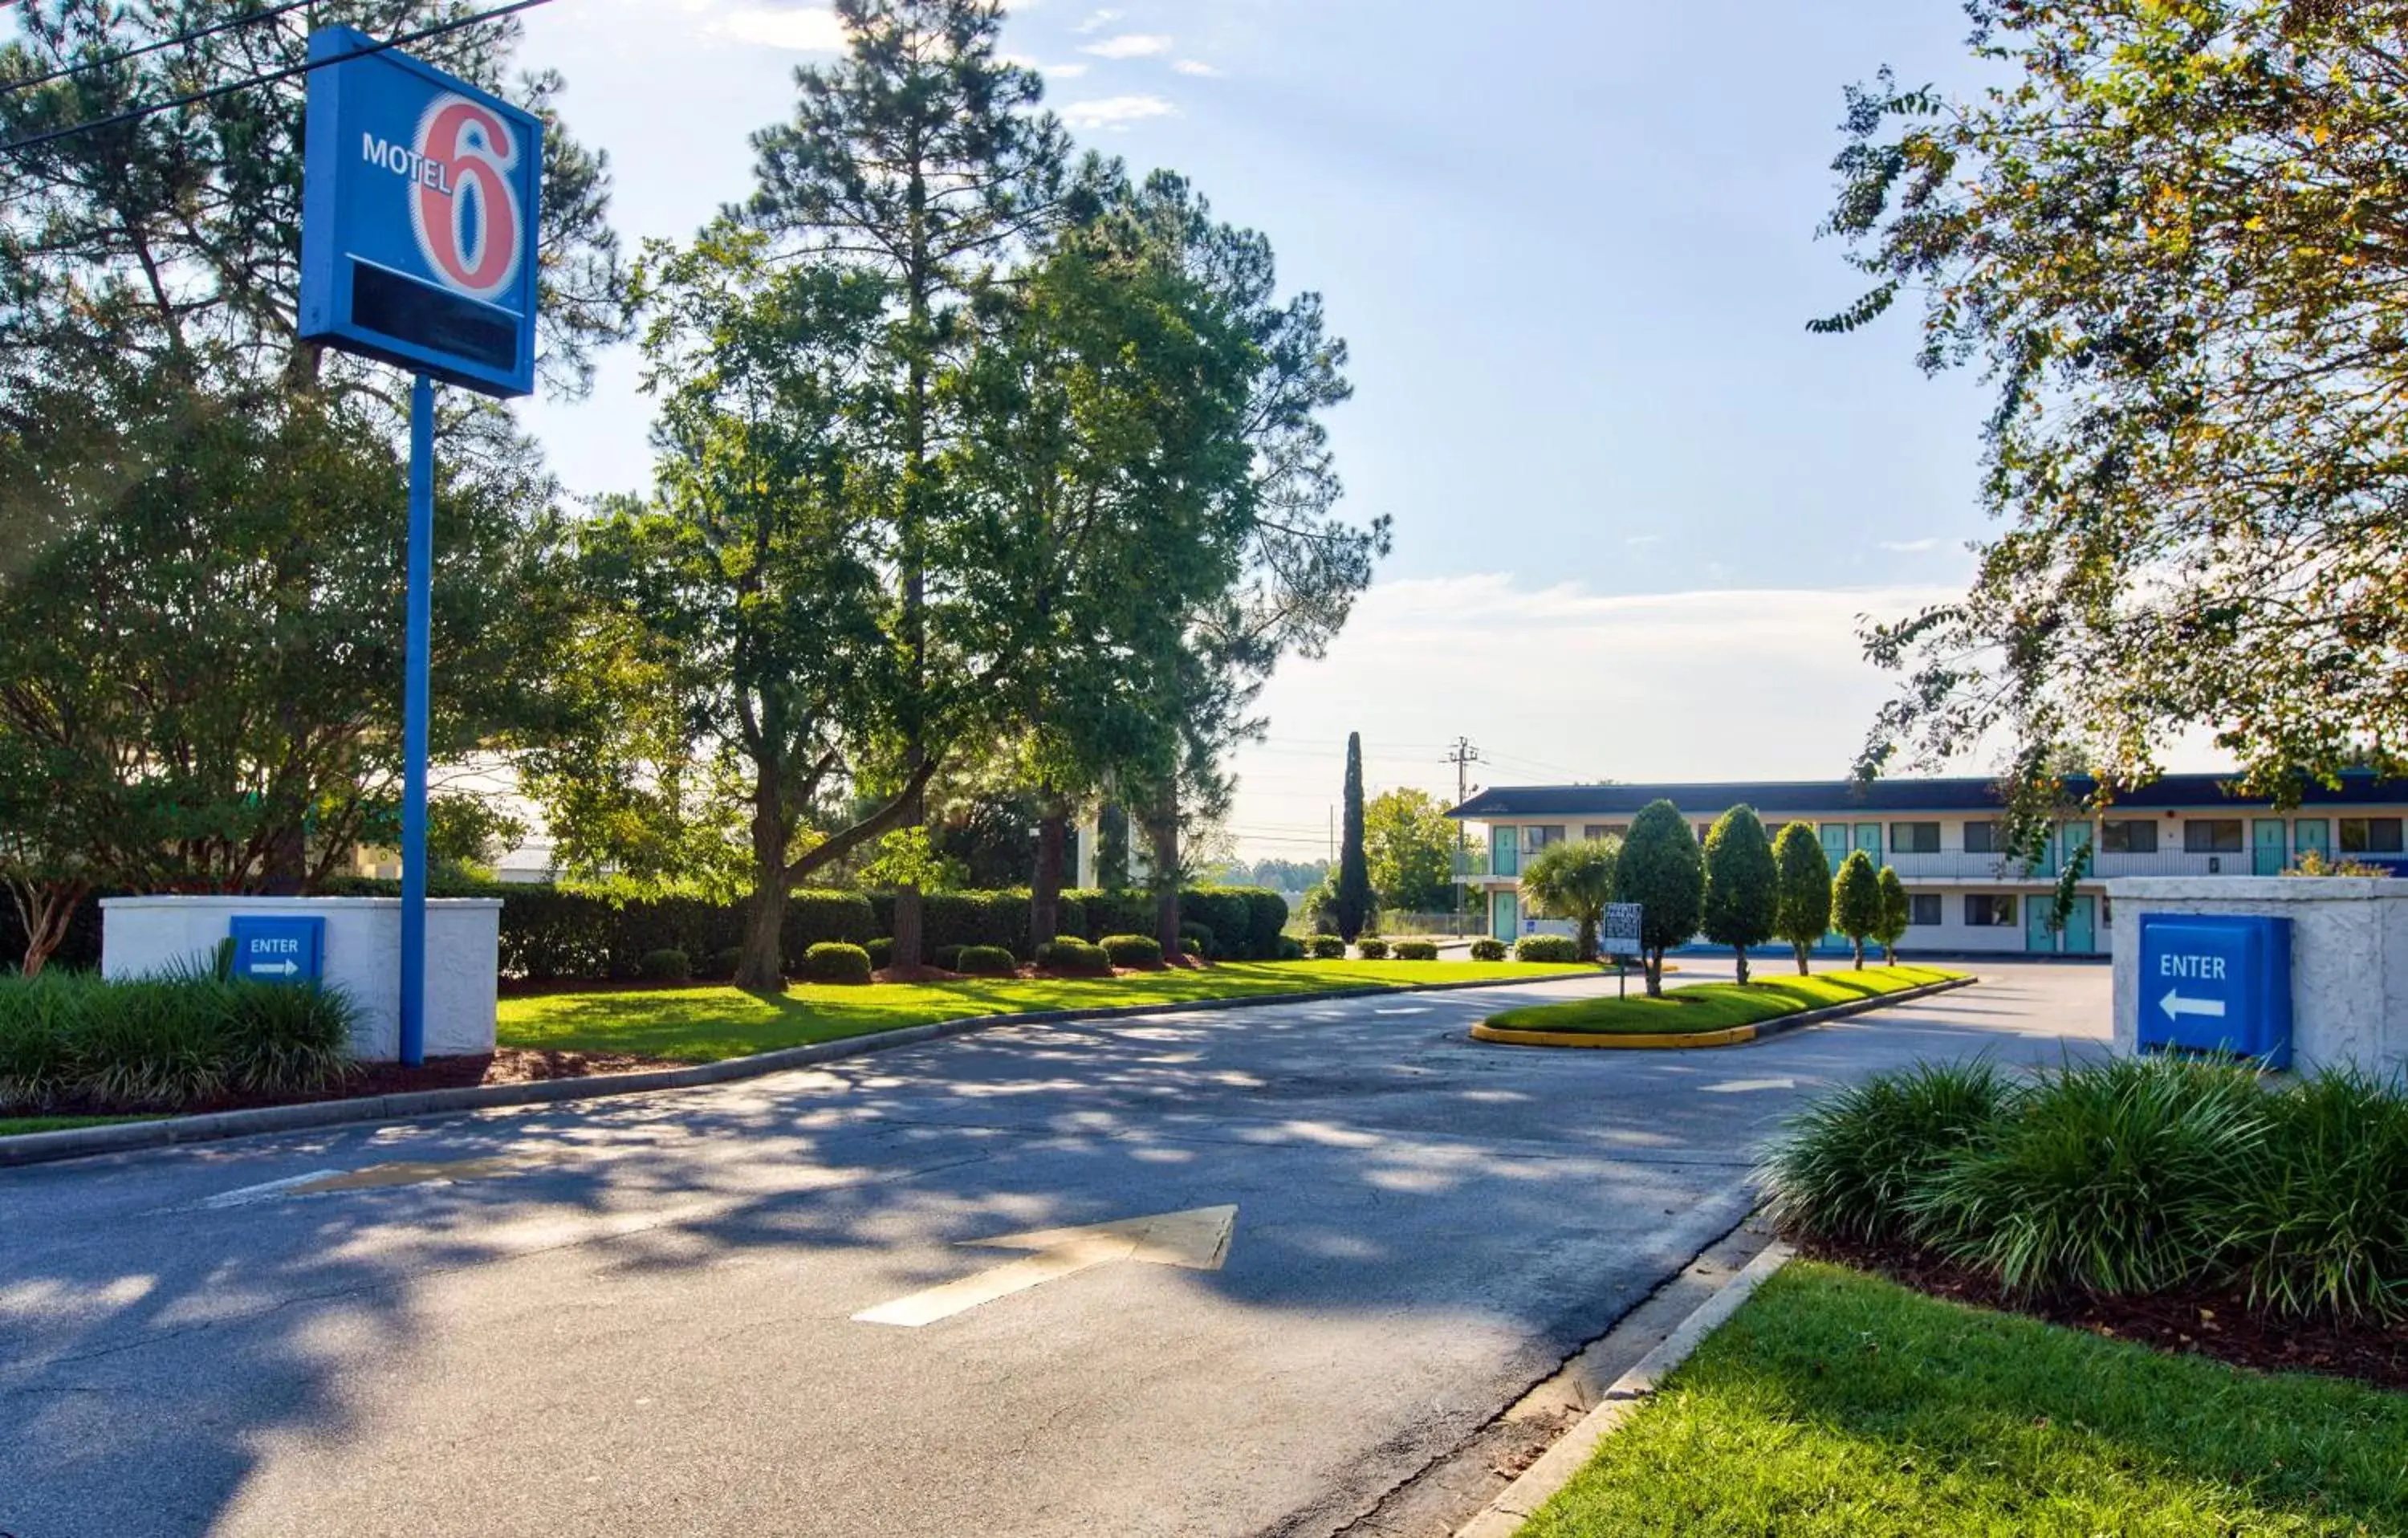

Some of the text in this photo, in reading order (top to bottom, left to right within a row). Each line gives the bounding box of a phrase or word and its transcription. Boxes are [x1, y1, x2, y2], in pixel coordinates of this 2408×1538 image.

[362, 96, 521, 294] MOTEL 6
[250, 938, 299, 953] ENTER
[2161, 954, 2226, 979] ENTER
